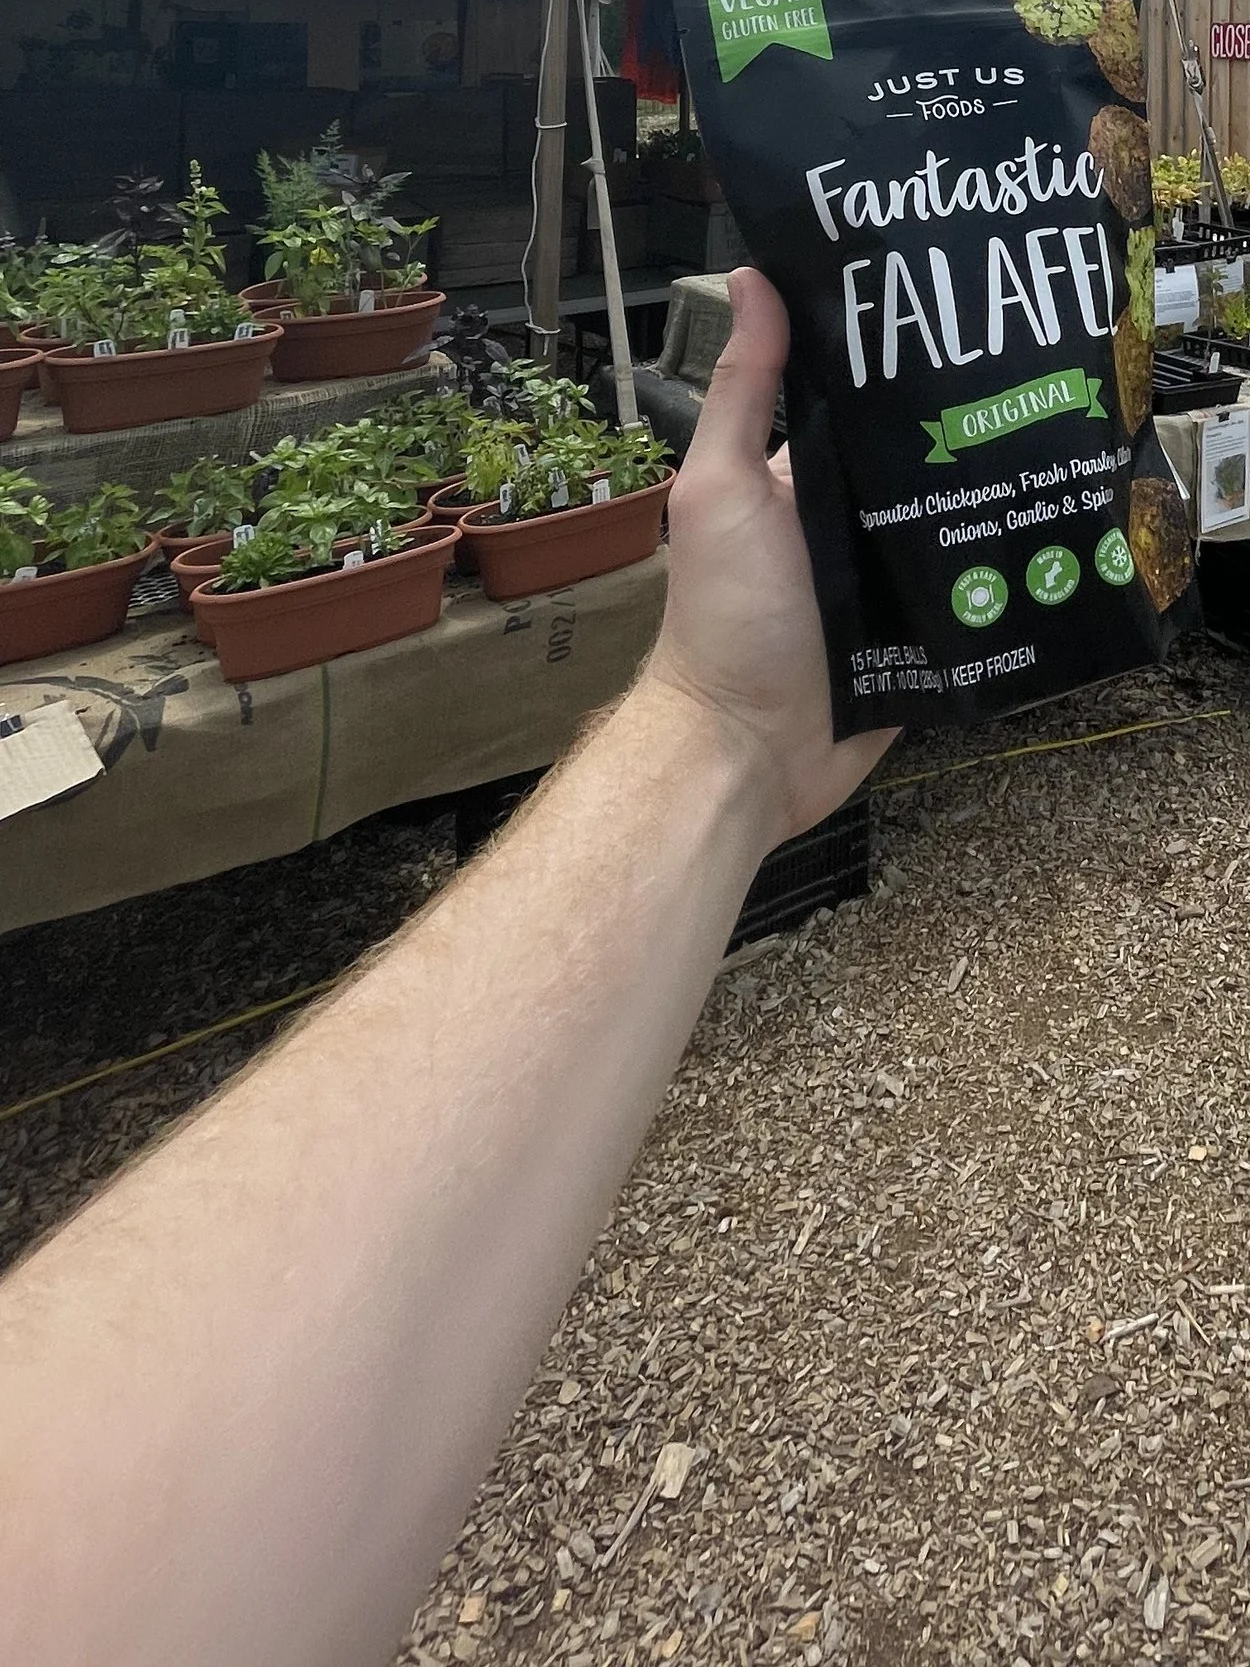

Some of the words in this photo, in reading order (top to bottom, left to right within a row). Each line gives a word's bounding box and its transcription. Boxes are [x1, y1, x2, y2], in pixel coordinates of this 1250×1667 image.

[722, 14, 779, 40] GLUTEN
[784, 7, 818, 29] FREE
[867, 68, 960, 102] JUST
[975, 67, 1025, 85] US
[915, 94, 985, 121] FOODS
[805, 136, 1105, 242] Fantastic
[962, 380, 1076, 438] ORIGINAL
[859, 497, 923, 532] Sprouted
[925, 481, 1017, 517] Chickpeas,
[1018, 463, 1068, 492] Fresh
[938, 519, 1003, 547] Onions,
[1006, 500, 1060, 531] Garlic
[1062, 495, 1078, 514] &
[850, 652, 864, 672] 15
[951, 661, 984, 688] KEEP
[986, 645, 1036, 679] FROZEN
